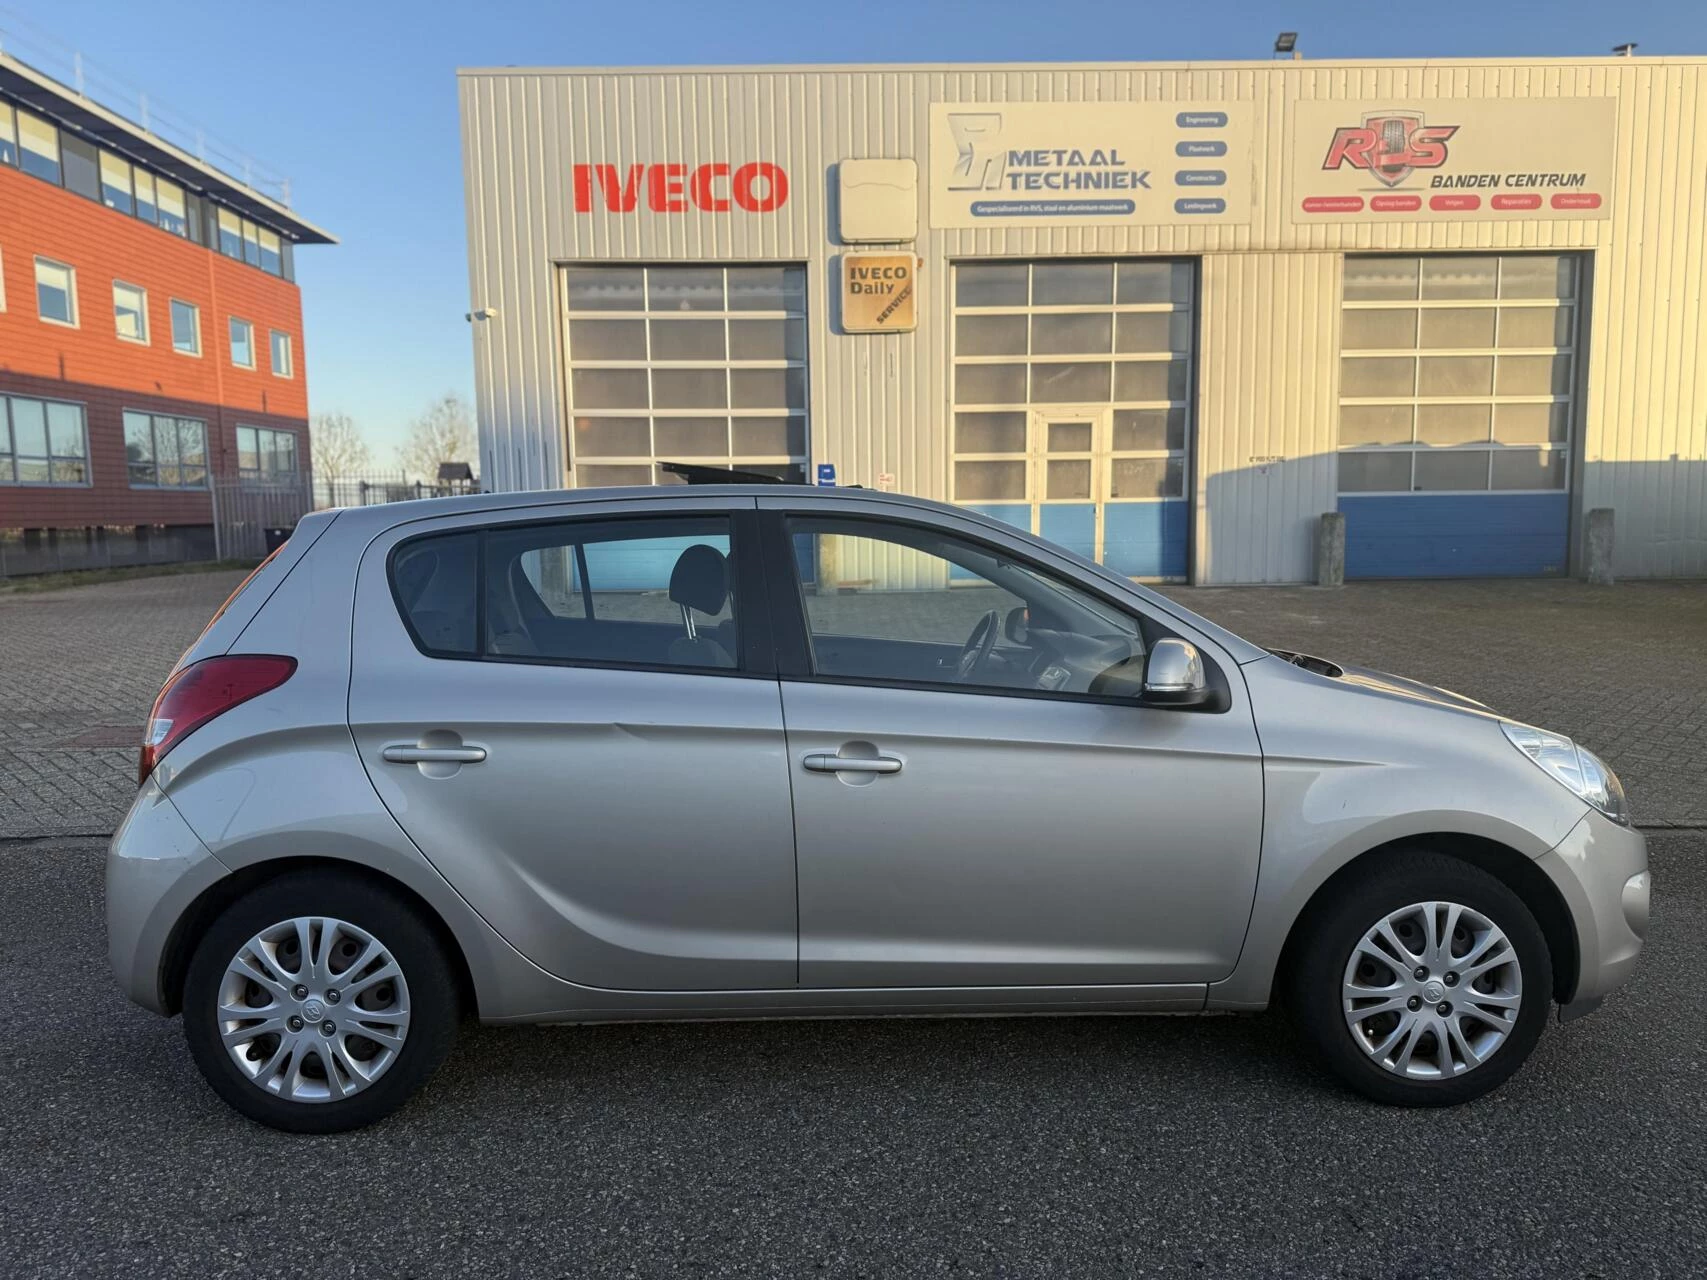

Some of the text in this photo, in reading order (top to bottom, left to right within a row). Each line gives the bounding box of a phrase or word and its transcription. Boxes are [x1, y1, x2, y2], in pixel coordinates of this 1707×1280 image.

[1008, 149, 1126, 168] METAAL
[572, 162, 789, 213] IVECO
[1006, 170, 1153, 191] TECHNIEK
[1430, 173, 1587, 189] BANDEN CENTRUM
[850, 266, 907, 281] IVECO
[850, 281, 895, 296] Daily
[876, 286, 912, 325] SERVICE
